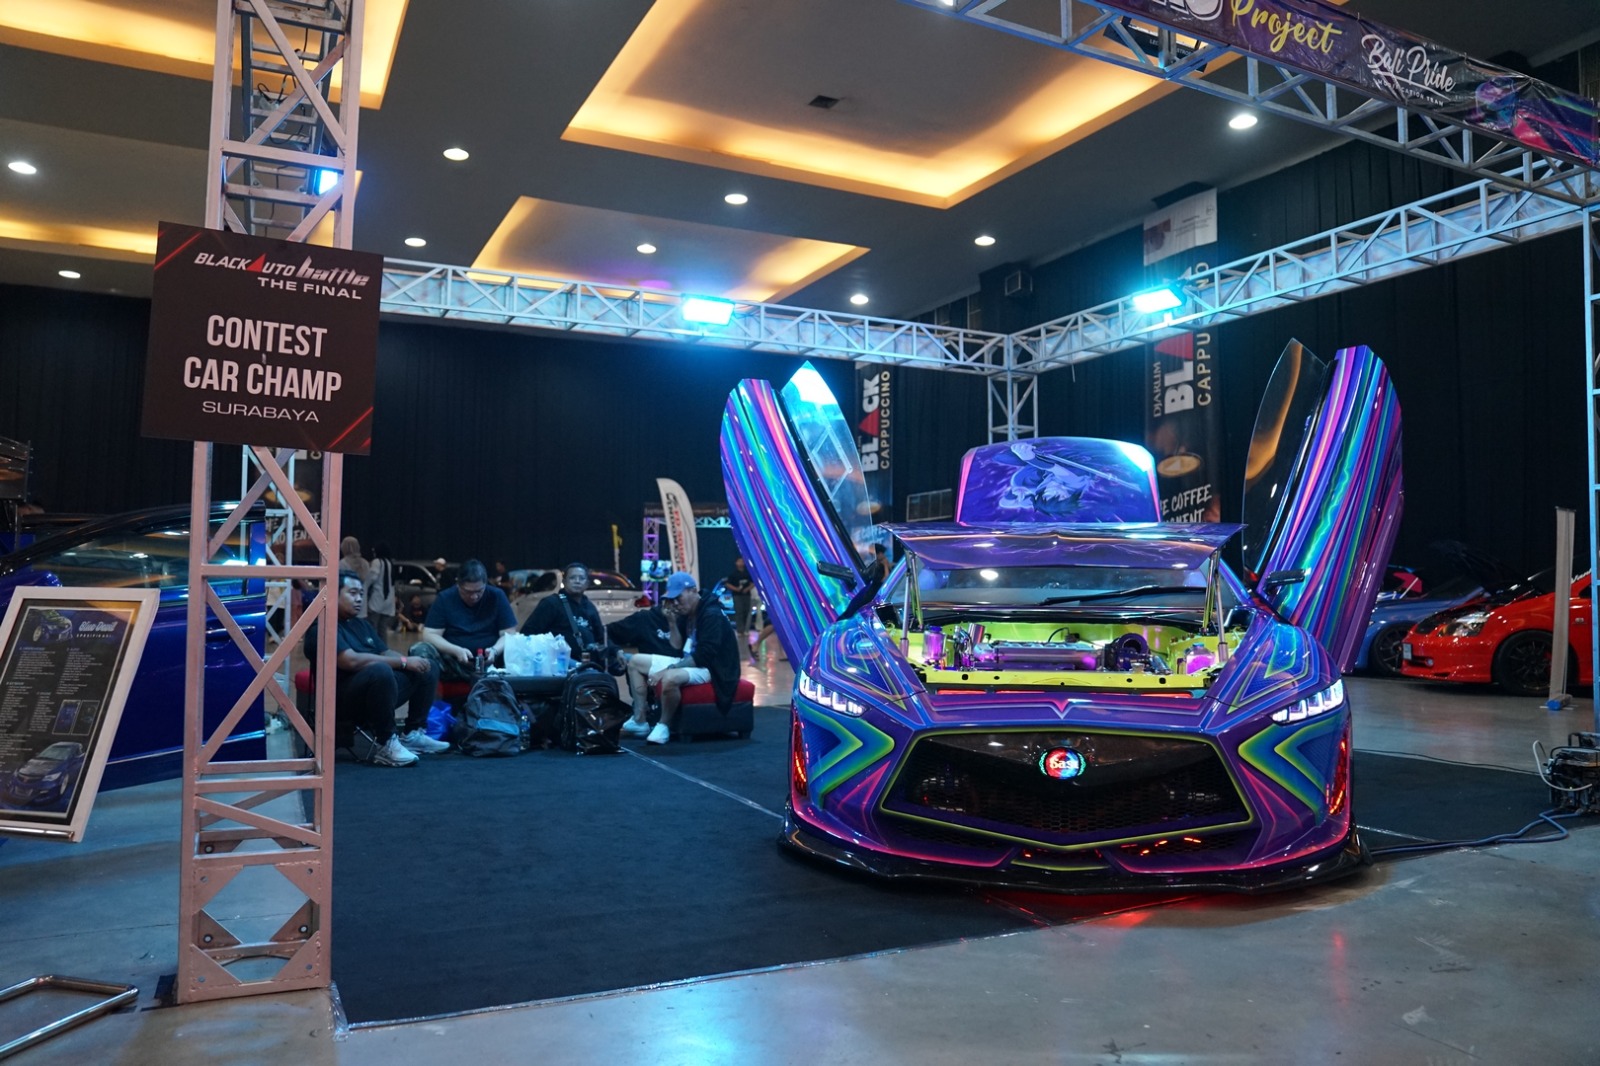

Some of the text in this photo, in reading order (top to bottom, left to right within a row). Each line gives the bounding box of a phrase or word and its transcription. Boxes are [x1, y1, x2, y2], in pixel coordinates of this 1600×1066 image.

[1231, 0, 1343, 53] Project
[1361, 34, 1457, 92] Bali Pride
[194, 253, 252, 271] BLACK
[258, 277, 363, 300] THE FINAL
[206, 314, 328, 358] CONTEST
[183, 356, 343, 402] CAR CHAMP
[1154, 331, 1194, 415] BLA
[202, 401, 320, 423] SURABAYA
[858, 373, 880, 473] BLACK
[880, 370, 891, 470] CAPPUCCINO
[1171, 484, 1213, 512] COFFEE
